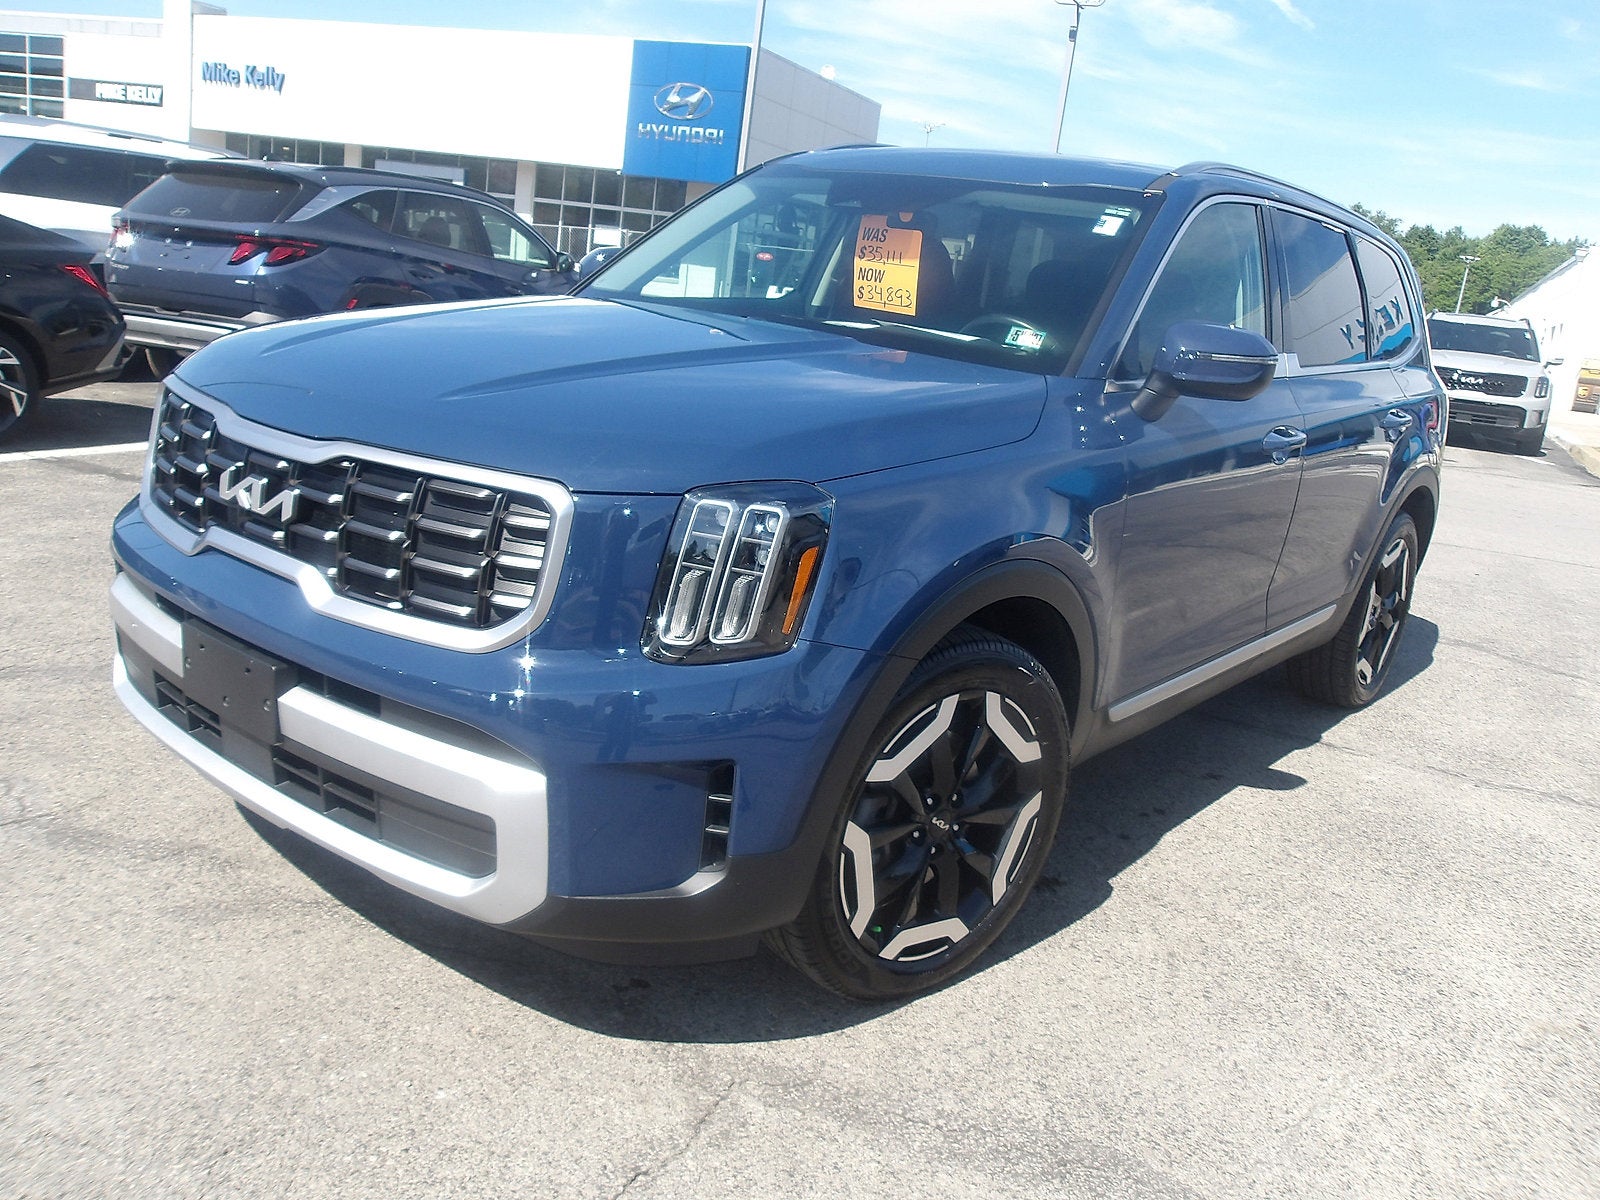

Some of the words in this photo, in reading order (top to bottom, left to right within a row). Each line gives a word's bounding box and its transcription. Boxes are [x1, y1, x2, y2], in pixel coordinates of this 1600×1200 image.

[202, 61, 240, 86] Mike
[244, 65, 285, 93] Kelly
[95, 82, 126, 100] MIKE
[127, 85, 162, 104] KELLY
[638, 122, 724, 145] HYUNDAI
[862, 227, 888, 243] WAS
[858, 245, 903, 265] $35,111
[857, 267, 886, 283] NOW
[857, 285, 913, 308] $34,893
[219, 466, 301, 522] KIA
